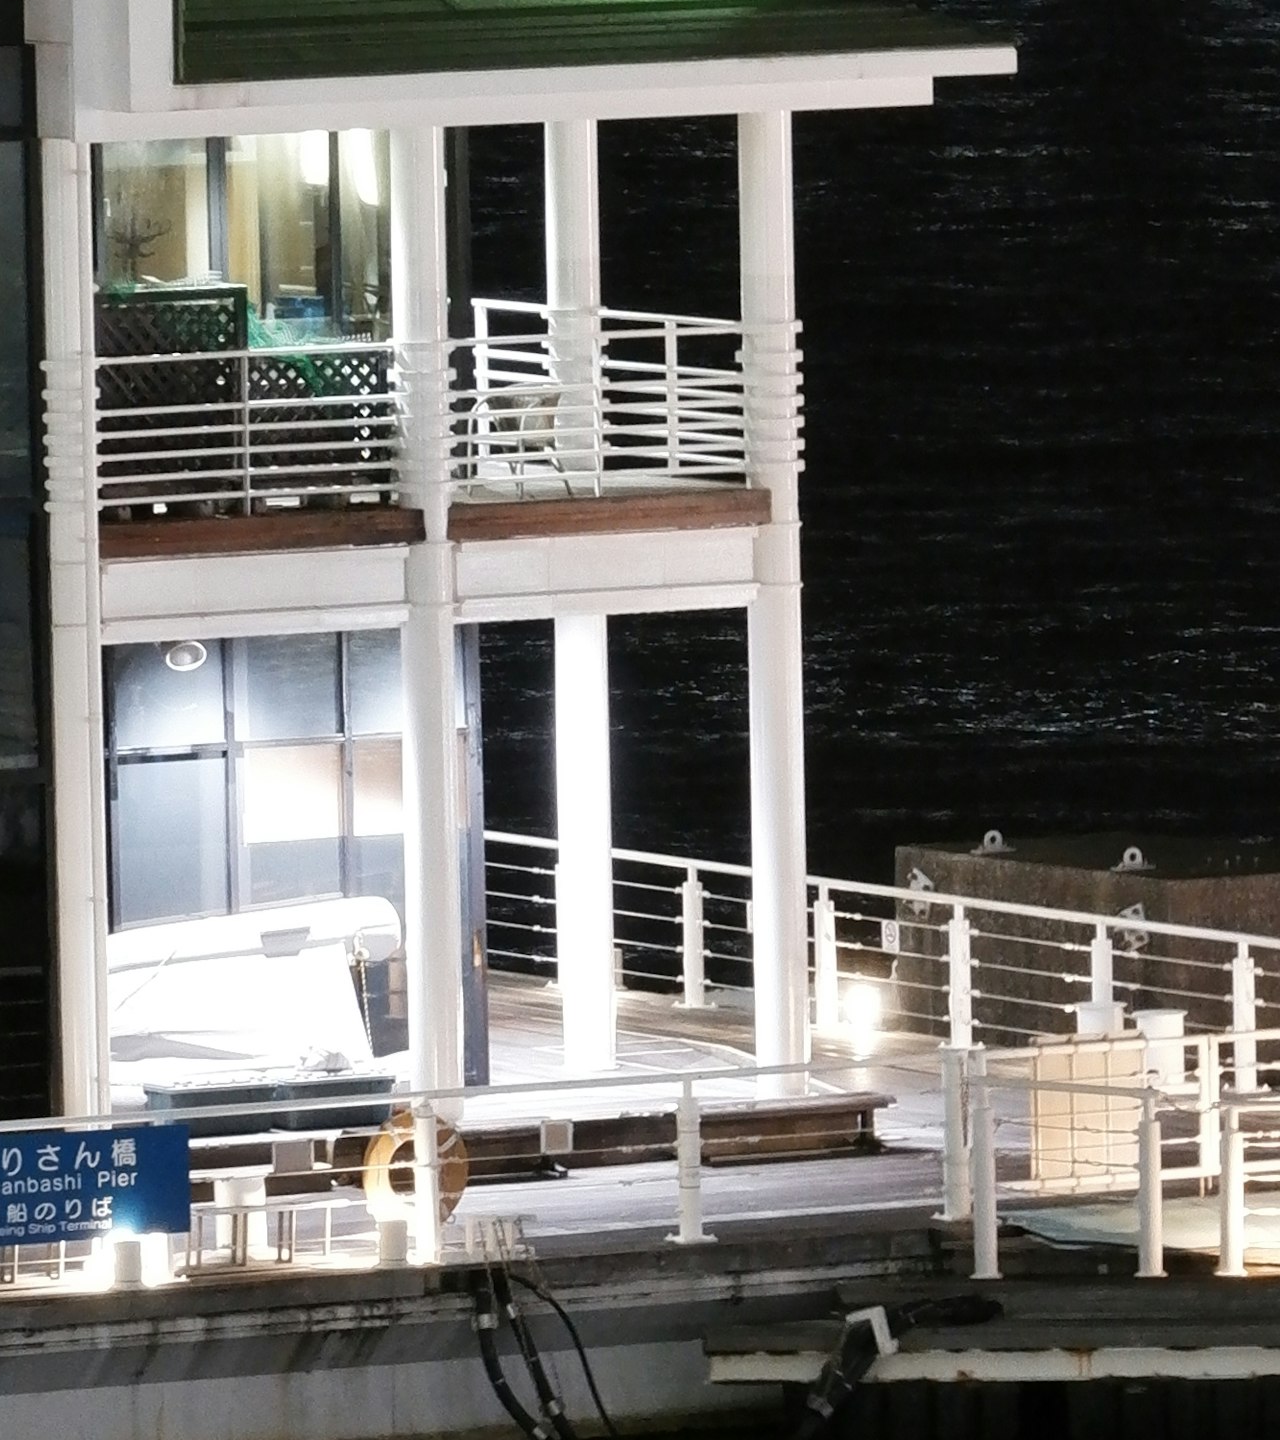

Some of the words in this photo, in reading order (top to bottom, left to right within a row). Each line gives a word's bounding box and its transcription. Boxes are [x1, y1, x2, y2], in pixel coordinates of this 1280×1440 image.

[97, 1171, 138, 1189] Pier
[28, 1223, 57, 1235] Ship
[60, 1218, 114, 1232] Terminal
